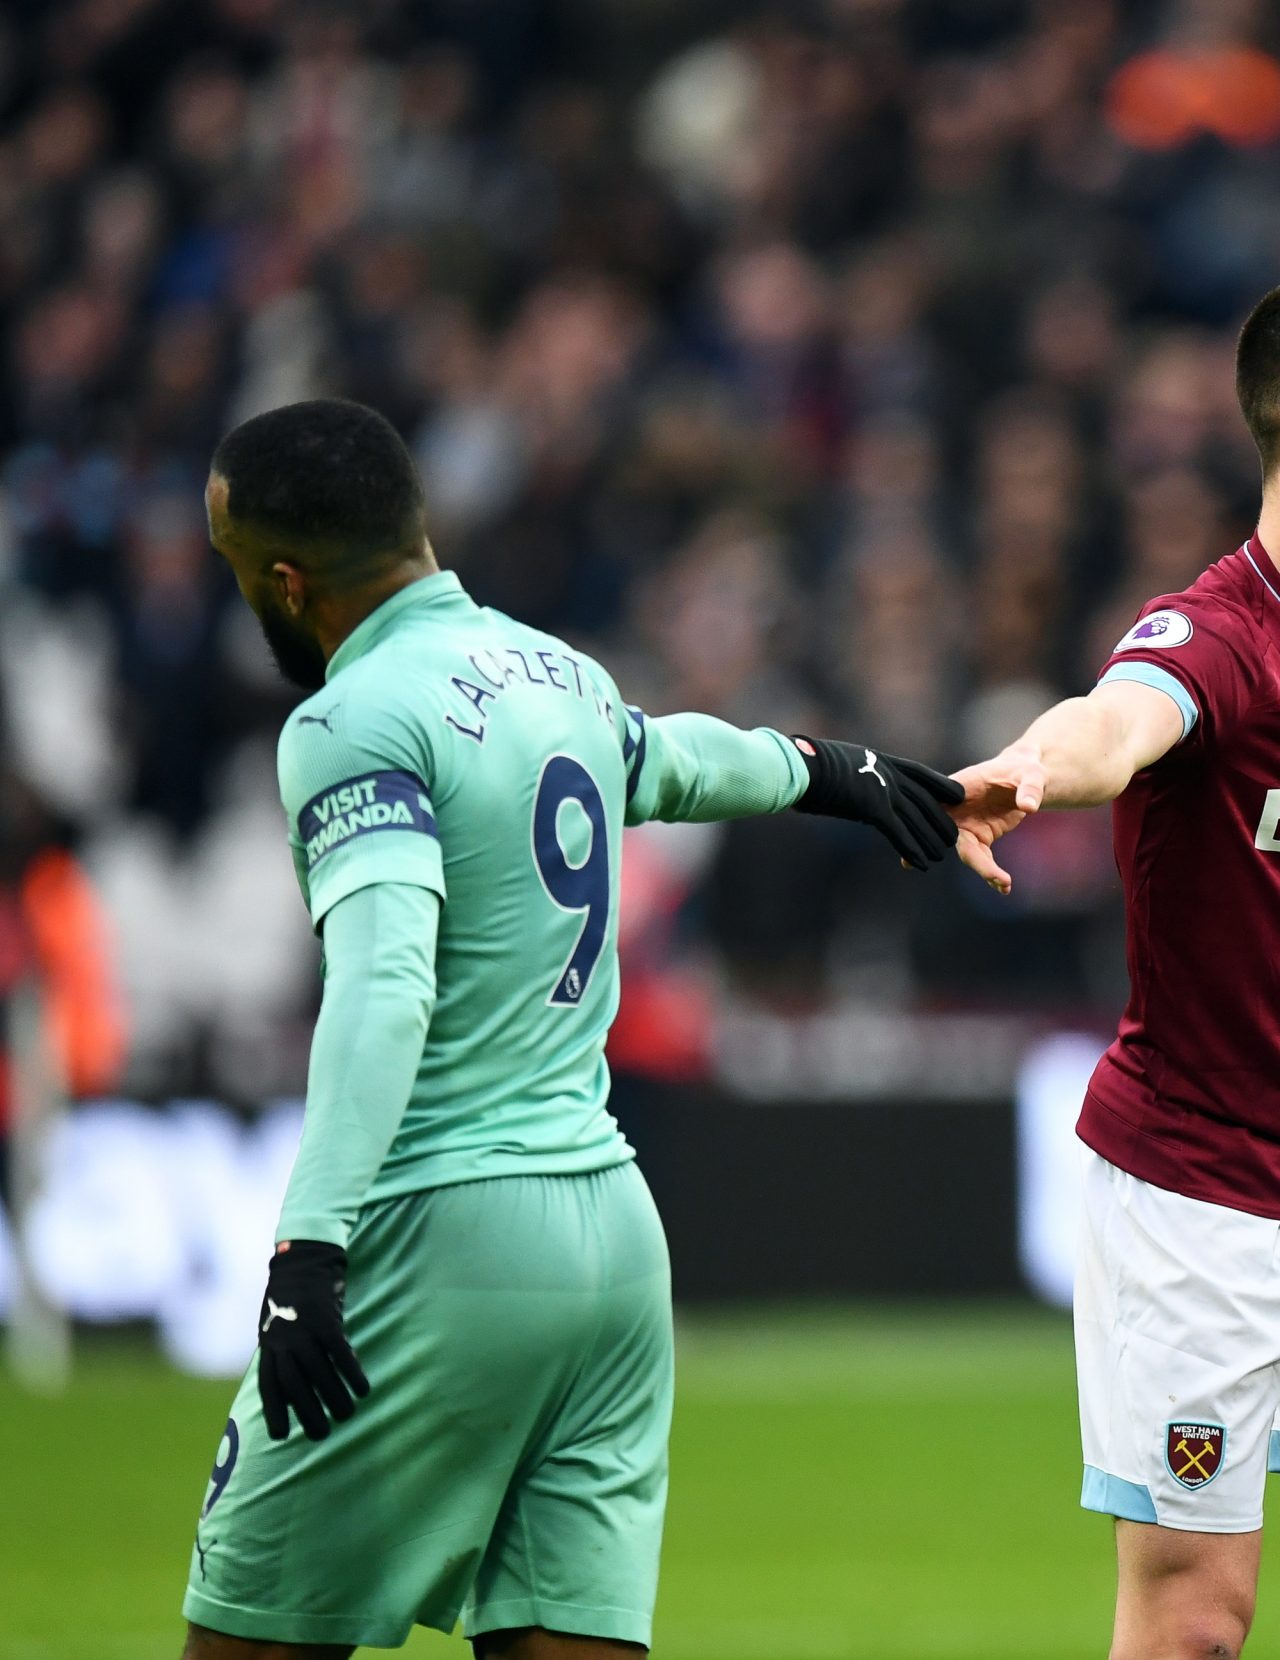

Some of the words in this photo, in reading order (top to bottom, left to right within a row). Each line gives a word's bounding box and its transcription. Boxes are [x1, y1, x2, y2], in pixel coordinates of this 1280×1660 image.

[446, 648, 616, 744] LACAZET
[312, 779, 377, 824] VISIT
[531, 752, 610, 1008] 9
[1173, 1425, 1197, 1434] WEST
[1198, 1427, 1220, 1437] HAM
[1182, 1432, 1210, 1440] UNITED
[200, 1417, 239, 1522] 9
